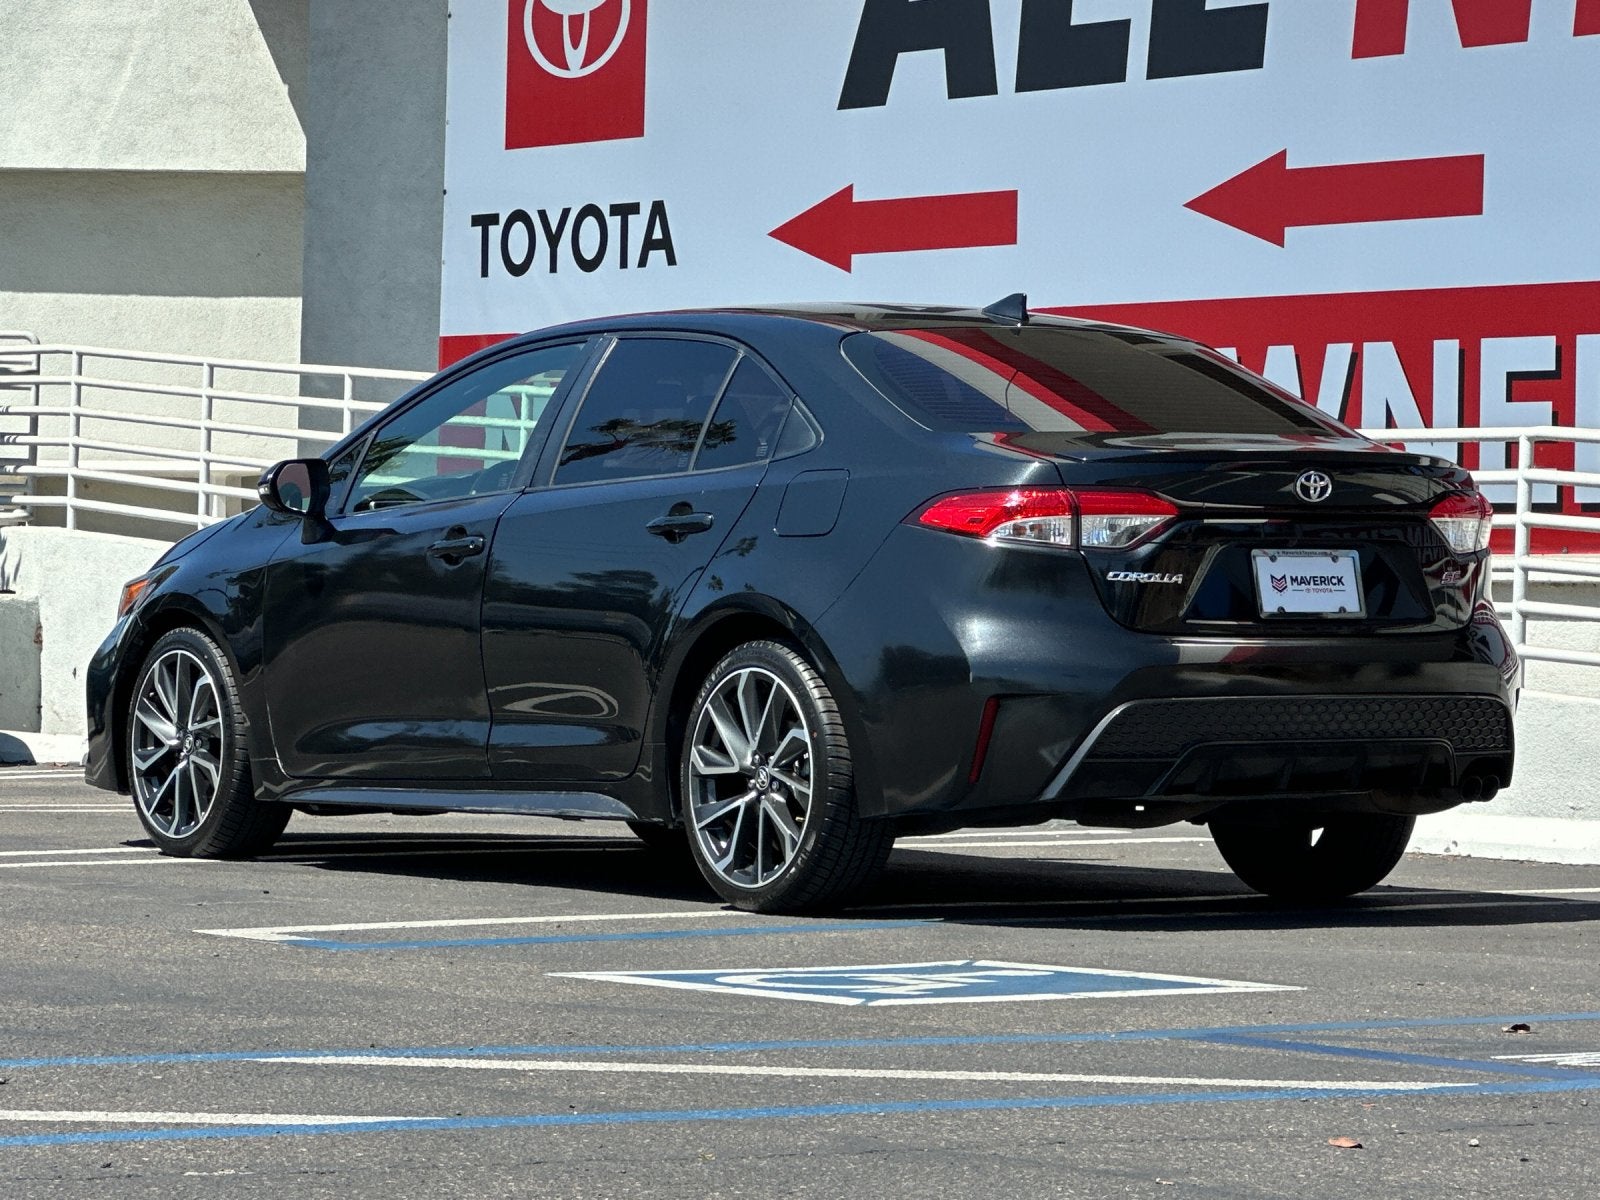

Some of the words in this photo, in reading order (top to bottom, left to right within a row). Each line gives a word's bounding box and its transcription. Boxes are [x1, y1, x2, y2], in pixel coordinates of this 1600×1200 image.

[471, 200, 677, 278] TOYOTA
[1106, 571, 1184, 585] COROLLA
[1290, 575, 1345, 587] MAVERICK
